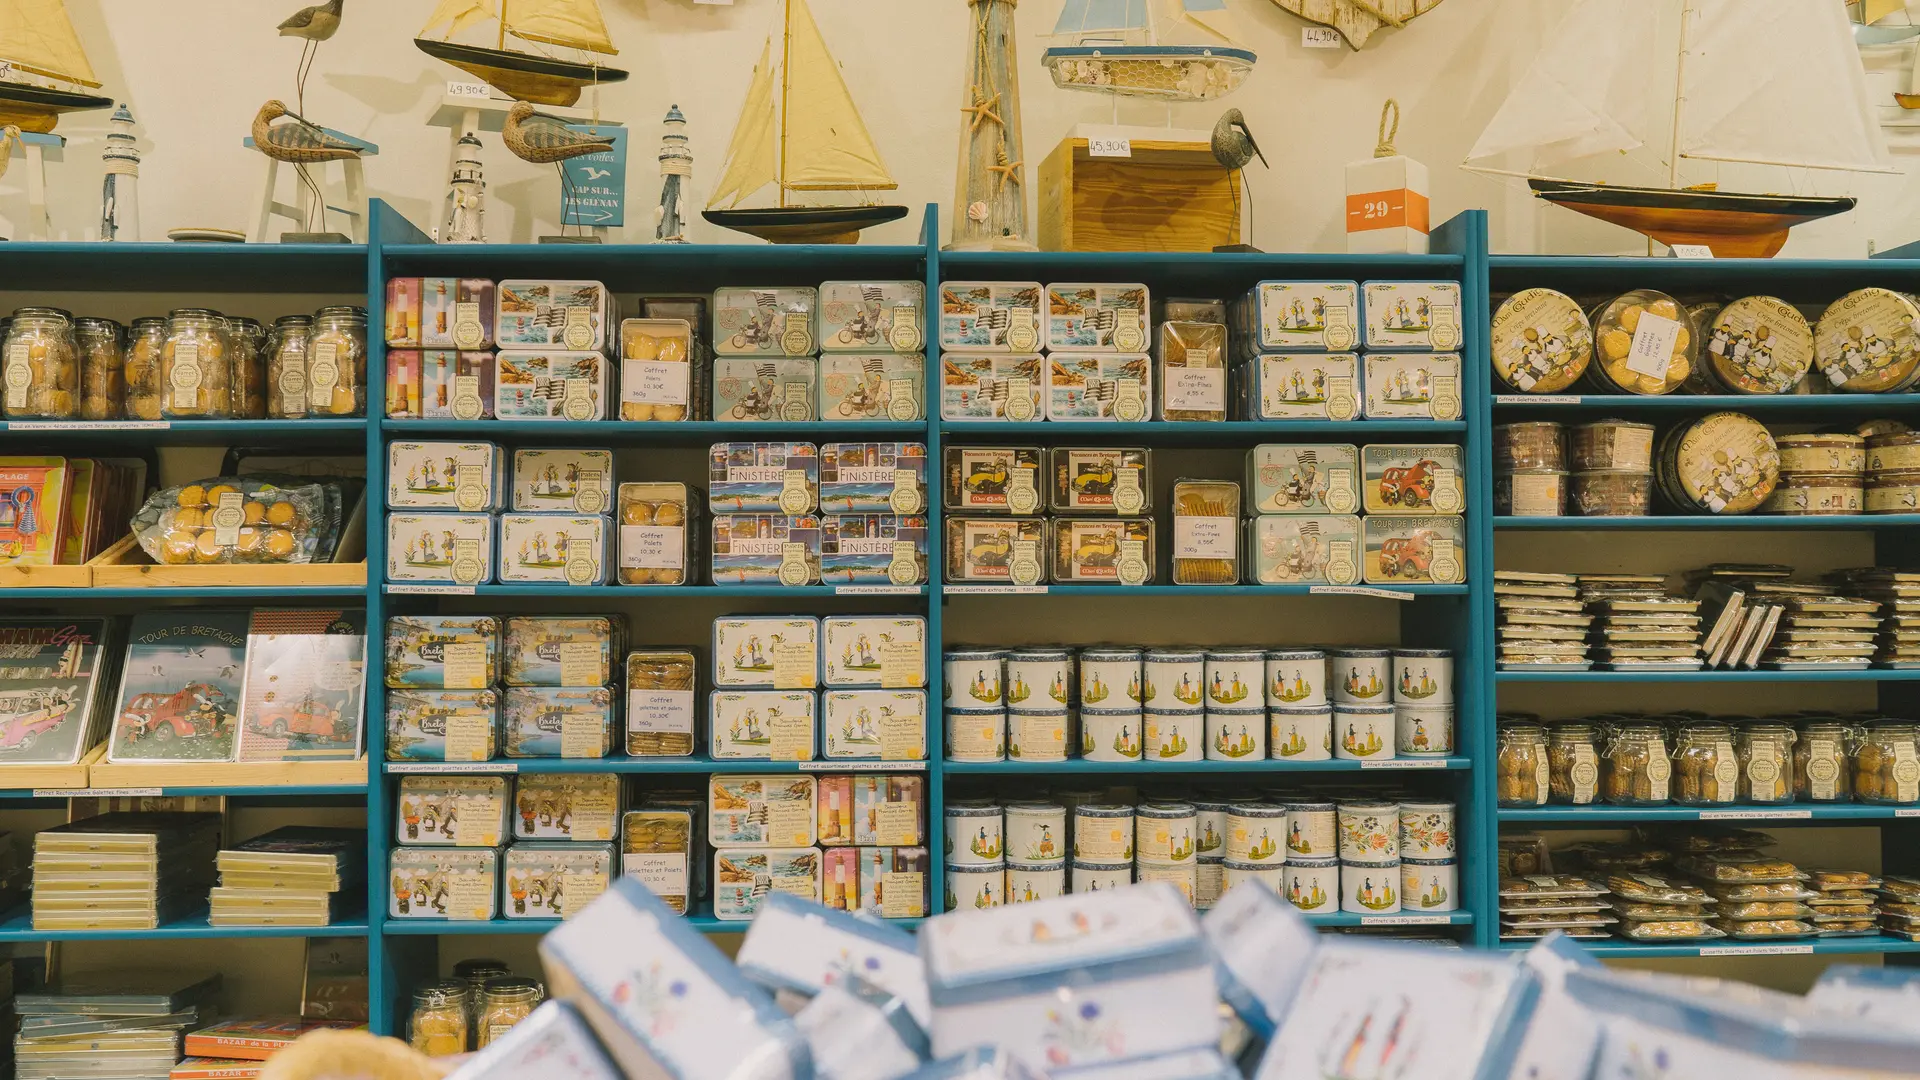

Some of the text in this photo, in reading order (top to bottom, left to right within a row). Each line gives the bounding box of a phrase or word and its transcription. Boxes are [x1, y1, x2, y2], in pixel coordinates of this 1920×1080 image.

[1307, 30, 1338, 43] 44,90€
[1089, 140, 1130, 153] 45,90€
[572, 186, 589, 195] CAP
[565, 197, 581, 206] LES
[632, 391, 646, 399] 360g
[1372, 449, 1458, 458] TOUR DE BRETAGNE
[1372, 519, 1459, 528] TOUR DE BRETAGNE
[138, 625, 244, 648] TOUR DE BRETAGNE
[638, 720, 652, 728] 360g
[217, 1038, 246, 1046] BAZAR
